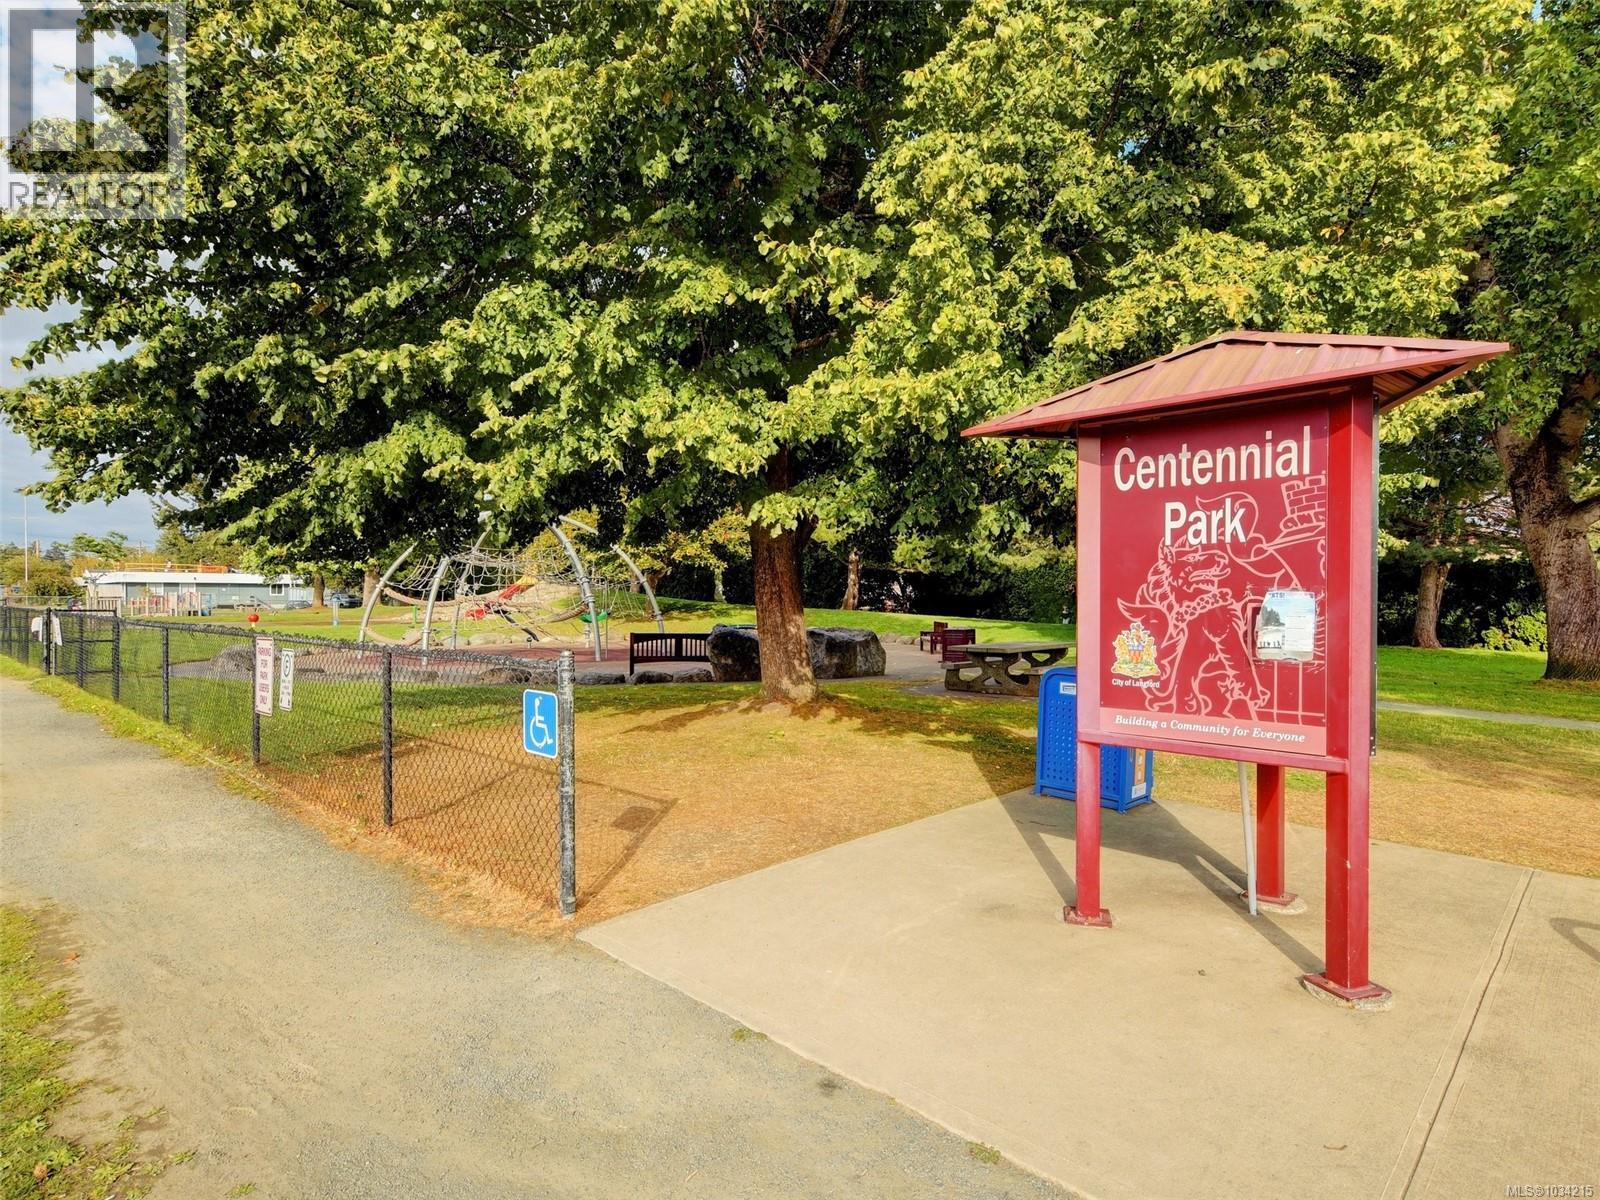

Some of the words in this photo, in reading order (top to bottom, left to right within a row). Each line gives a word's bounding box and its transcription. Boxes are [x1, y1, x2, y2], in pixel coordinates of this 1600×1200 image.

[1113, 425, 1311, 492] Centennial
[1163, 498, 1246, 547] Park
[1112, 678, 1124, 687] City
[1115, 714, 1158, 729] Building
[1160, 720, 1168, 729] a
[1170, 719, 1231, 736] Community
[1232, 725, 1250, 738] for
[1252, 726, 1306, 743] Everyone
